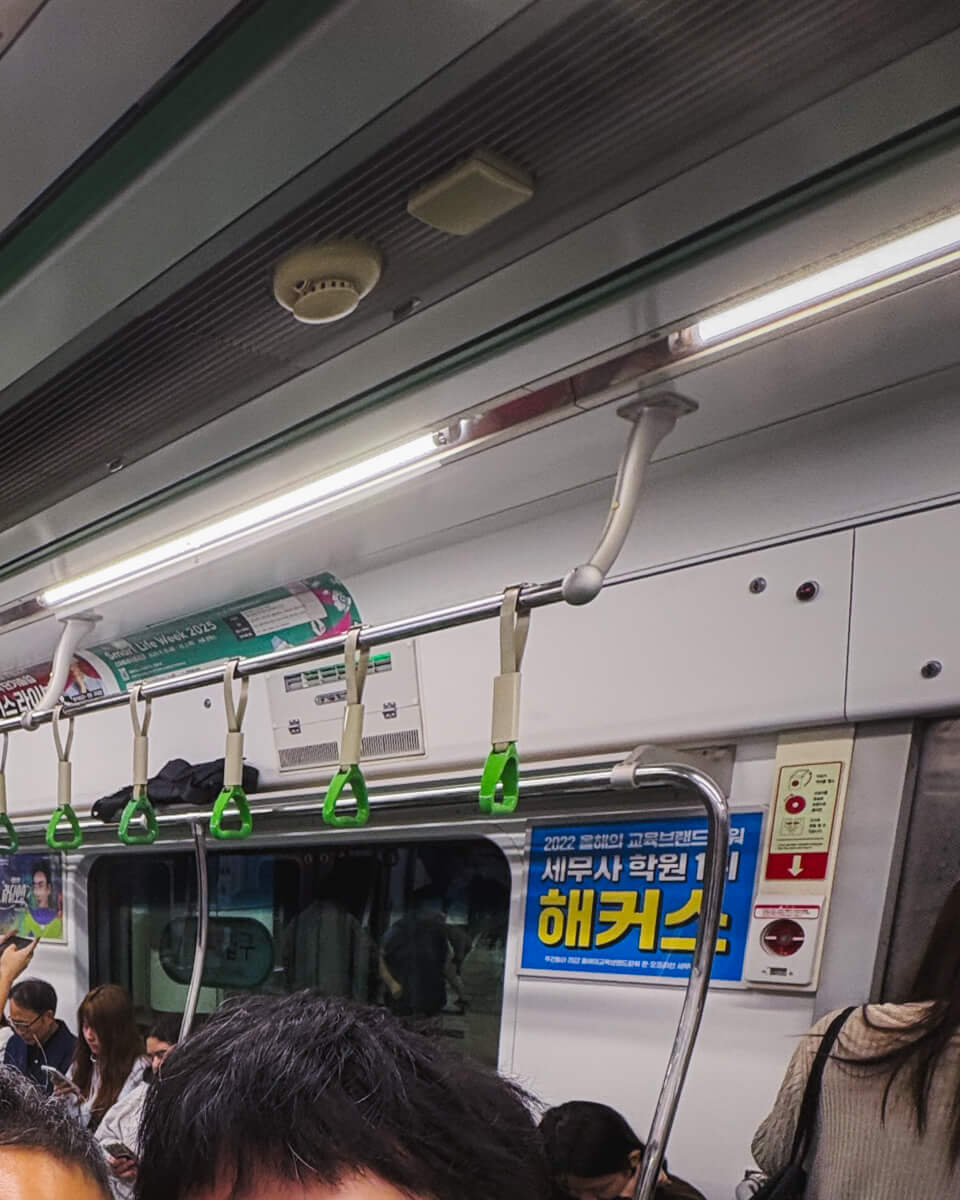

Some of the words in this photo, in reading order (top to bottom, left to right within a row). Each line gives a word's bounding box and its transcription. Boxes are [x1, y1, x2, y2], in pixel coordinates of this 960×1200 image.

[136, 638, 158, 652] Life
[155, 630, 189, 647] Week
[190, 619, 217, 637] 2025
[544, 835, 576, 852] 2022
[628, 827, 745, 849] 교육브랜드워
[542, 854, 623, 883] 세무사
[629, 852, 688, 882] 학원
[537, 888, 730, 953] 해커스
